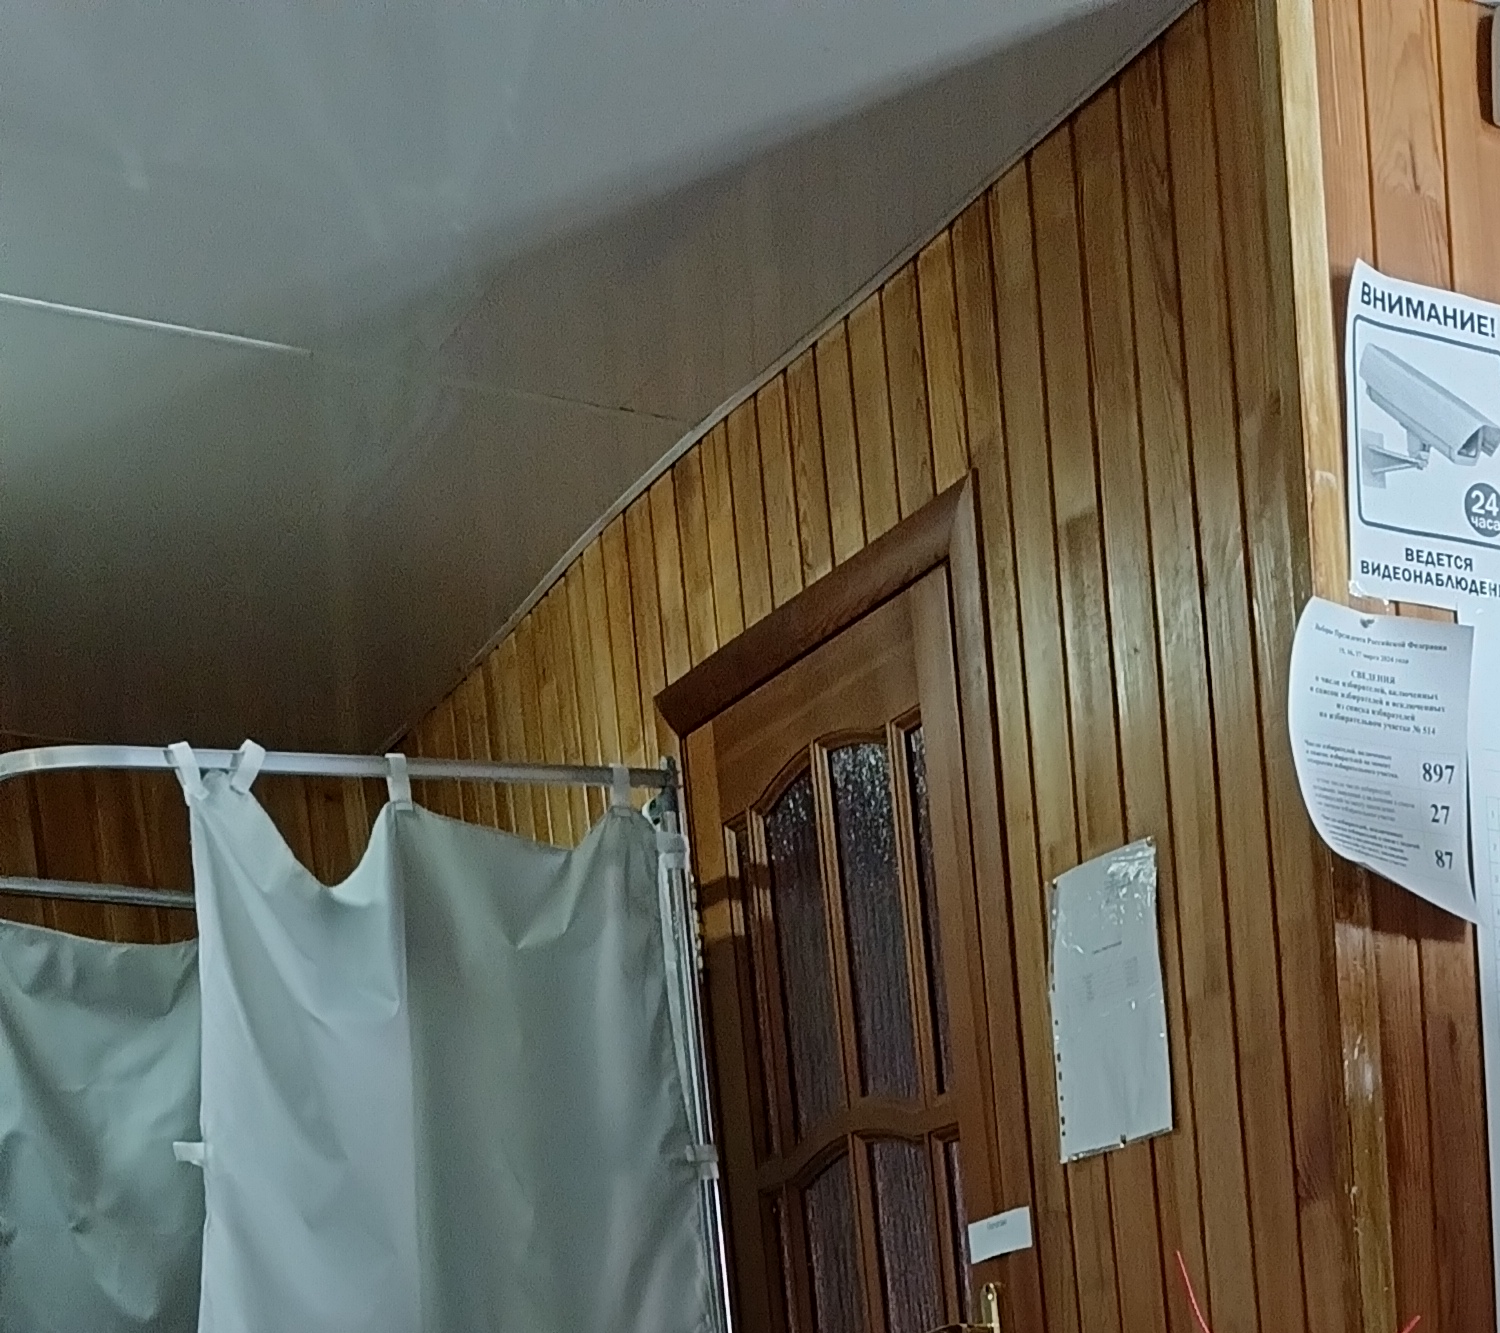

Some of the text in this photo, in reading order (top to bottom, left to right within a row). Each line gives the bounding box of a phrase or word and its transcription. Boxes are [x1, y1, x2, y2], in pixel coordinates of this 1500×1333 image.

[1361, 282, 1496, 338] ВНИМАНИЕ!
[1470, 490, 1499, 516] 24
[1471, 516, 1500, 532] часа
[1405, 548, 1473, 572] ВЕДЕТСЯ
[1351, 670, 1396, 685] СВЕДЕНИЯ
[1422, 726, 1436, 735] 514
[1422, 762, 1455, 785] 897
[1430, 803, 1450, 825] 27
[1434, 850, 1453, 870] 87
